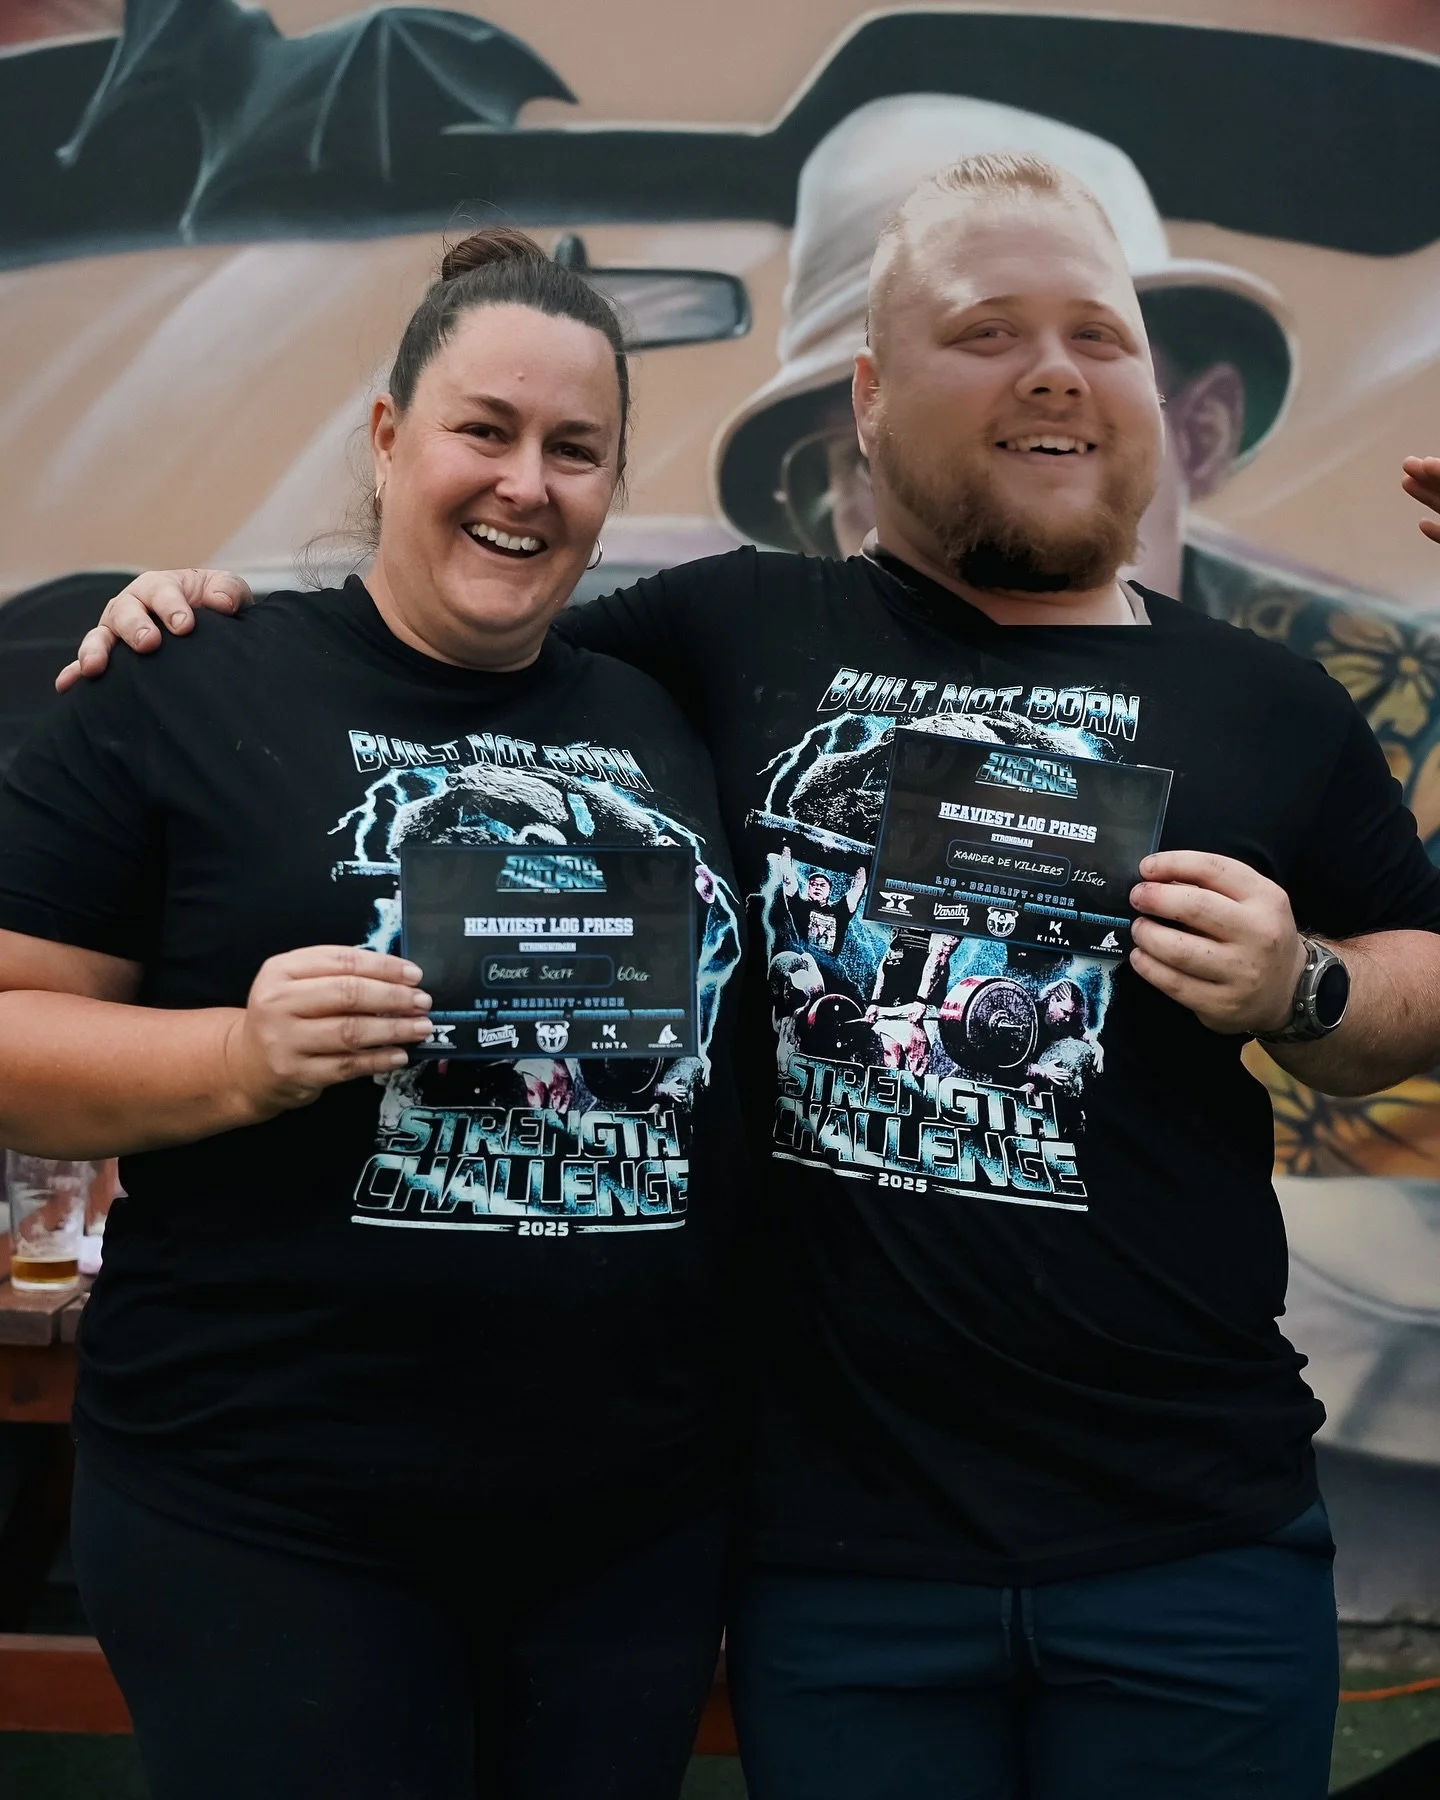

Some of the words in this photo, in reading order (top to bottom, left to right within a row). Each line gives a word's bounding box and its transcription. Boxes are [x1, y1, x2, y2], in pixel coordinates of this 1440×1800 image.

[815, 667, 937, 713] BUILT
[937, 684, 1022, 714] NOT
[1027, 686, 1140, 742] BORN
[348, 730, 458, 773] BUILT
[466, 733, 537, 768] NOT
[543, 746, 655, 793] BORN
[984, 752, 1073, 778] STRENGTH
[975, 764, 1079, 796] CHALLENGE
[938, 802, 1014, 828] HEAVIEST
[1017, 815, 1046, 832] LOG
[1049, 820, 1098, 841] PRESS
[990, 833, 1034, 848] STRONGMAN
[953, 850, 995, 866] XANDER
[998, 857, 1012, 868] DE
[1014, 860, 1065, 876] VILLIERS
[935, 875, 957, 888] LOG
[969, 881, 1028, 899] DEADLIFT
[1037, 892, 1075, 907] STONE
[464, 917, 544, 935] HEAVIEST
[550, 917, 579, 935] LOG
[583, 917, 634, 935] PRESS
[933, 903, 970, 926] Varsity
[1036, 934, 1070, 947] KINTA
[591, 1041, 628, 1050] KINTA
[779, 1052, 1060, 1139] STRENGTH
[386, 1106, 681, 1158] STRENGTH
[772, 1096, 1088, 1197] CHALLENGE
[353, 1153, 690, 1216] CHALLENGE
[878, 1172, 928, 1193] 2025
[517, 1220, 570, 1237] 2025
